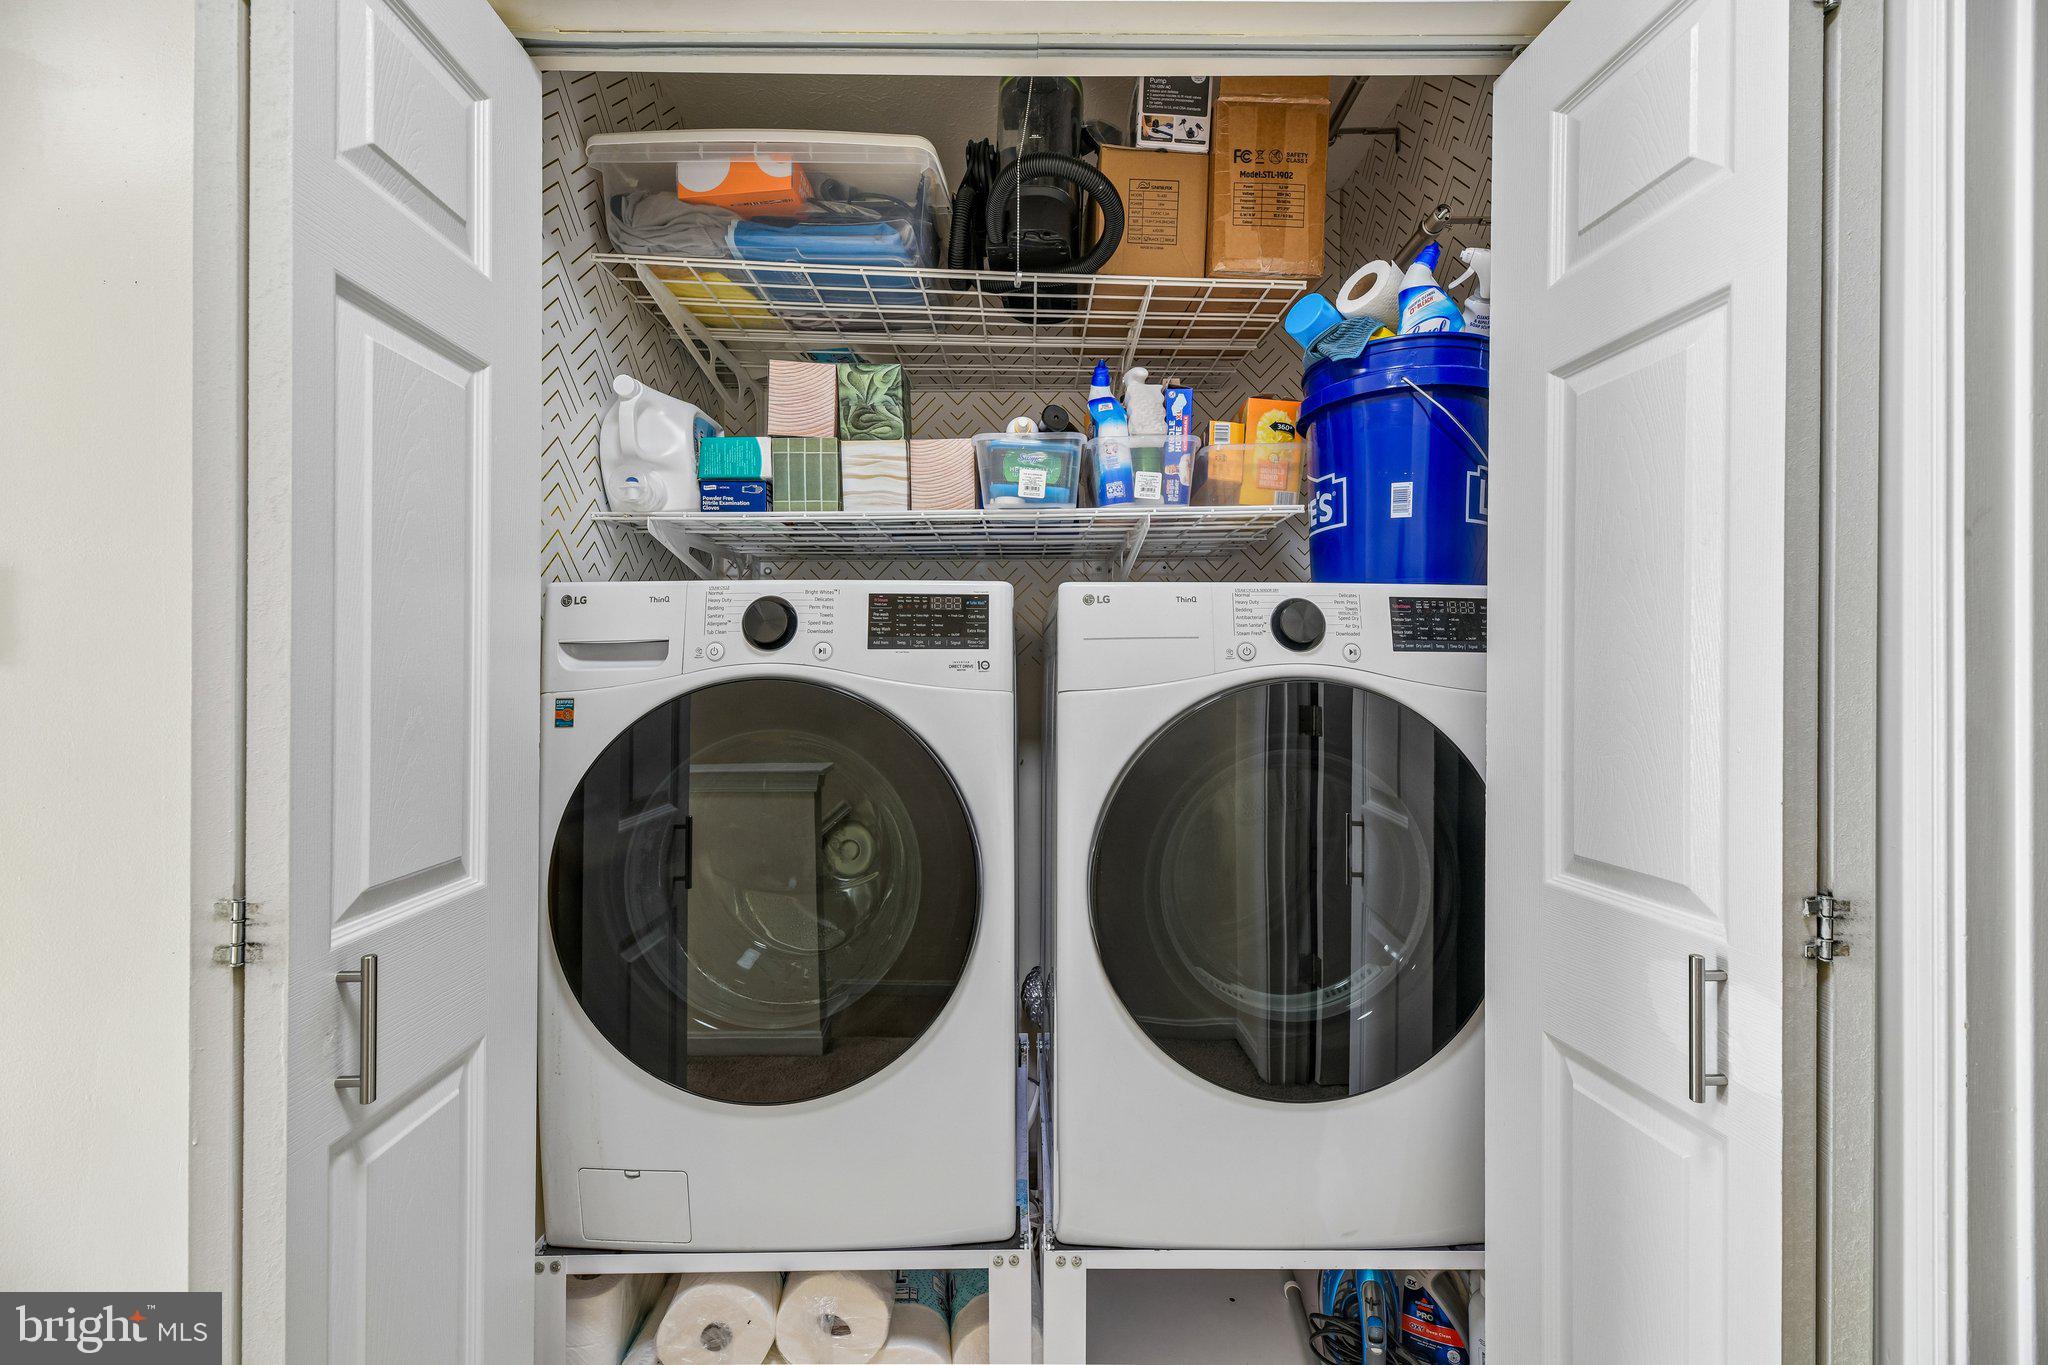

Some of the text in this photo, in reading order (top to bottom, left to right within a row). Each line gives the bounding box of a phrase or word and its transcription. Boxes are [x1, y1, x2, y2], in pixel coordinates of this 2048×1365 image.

[1417, 296, 1433, 308] BLEACH
[574, 596, 587, 604] LG
[1097, 595, 1110, 604] LG
[1416, 1310, 1433, 1321] PRO
[1410, 1322, 1425, 1331] OXY
